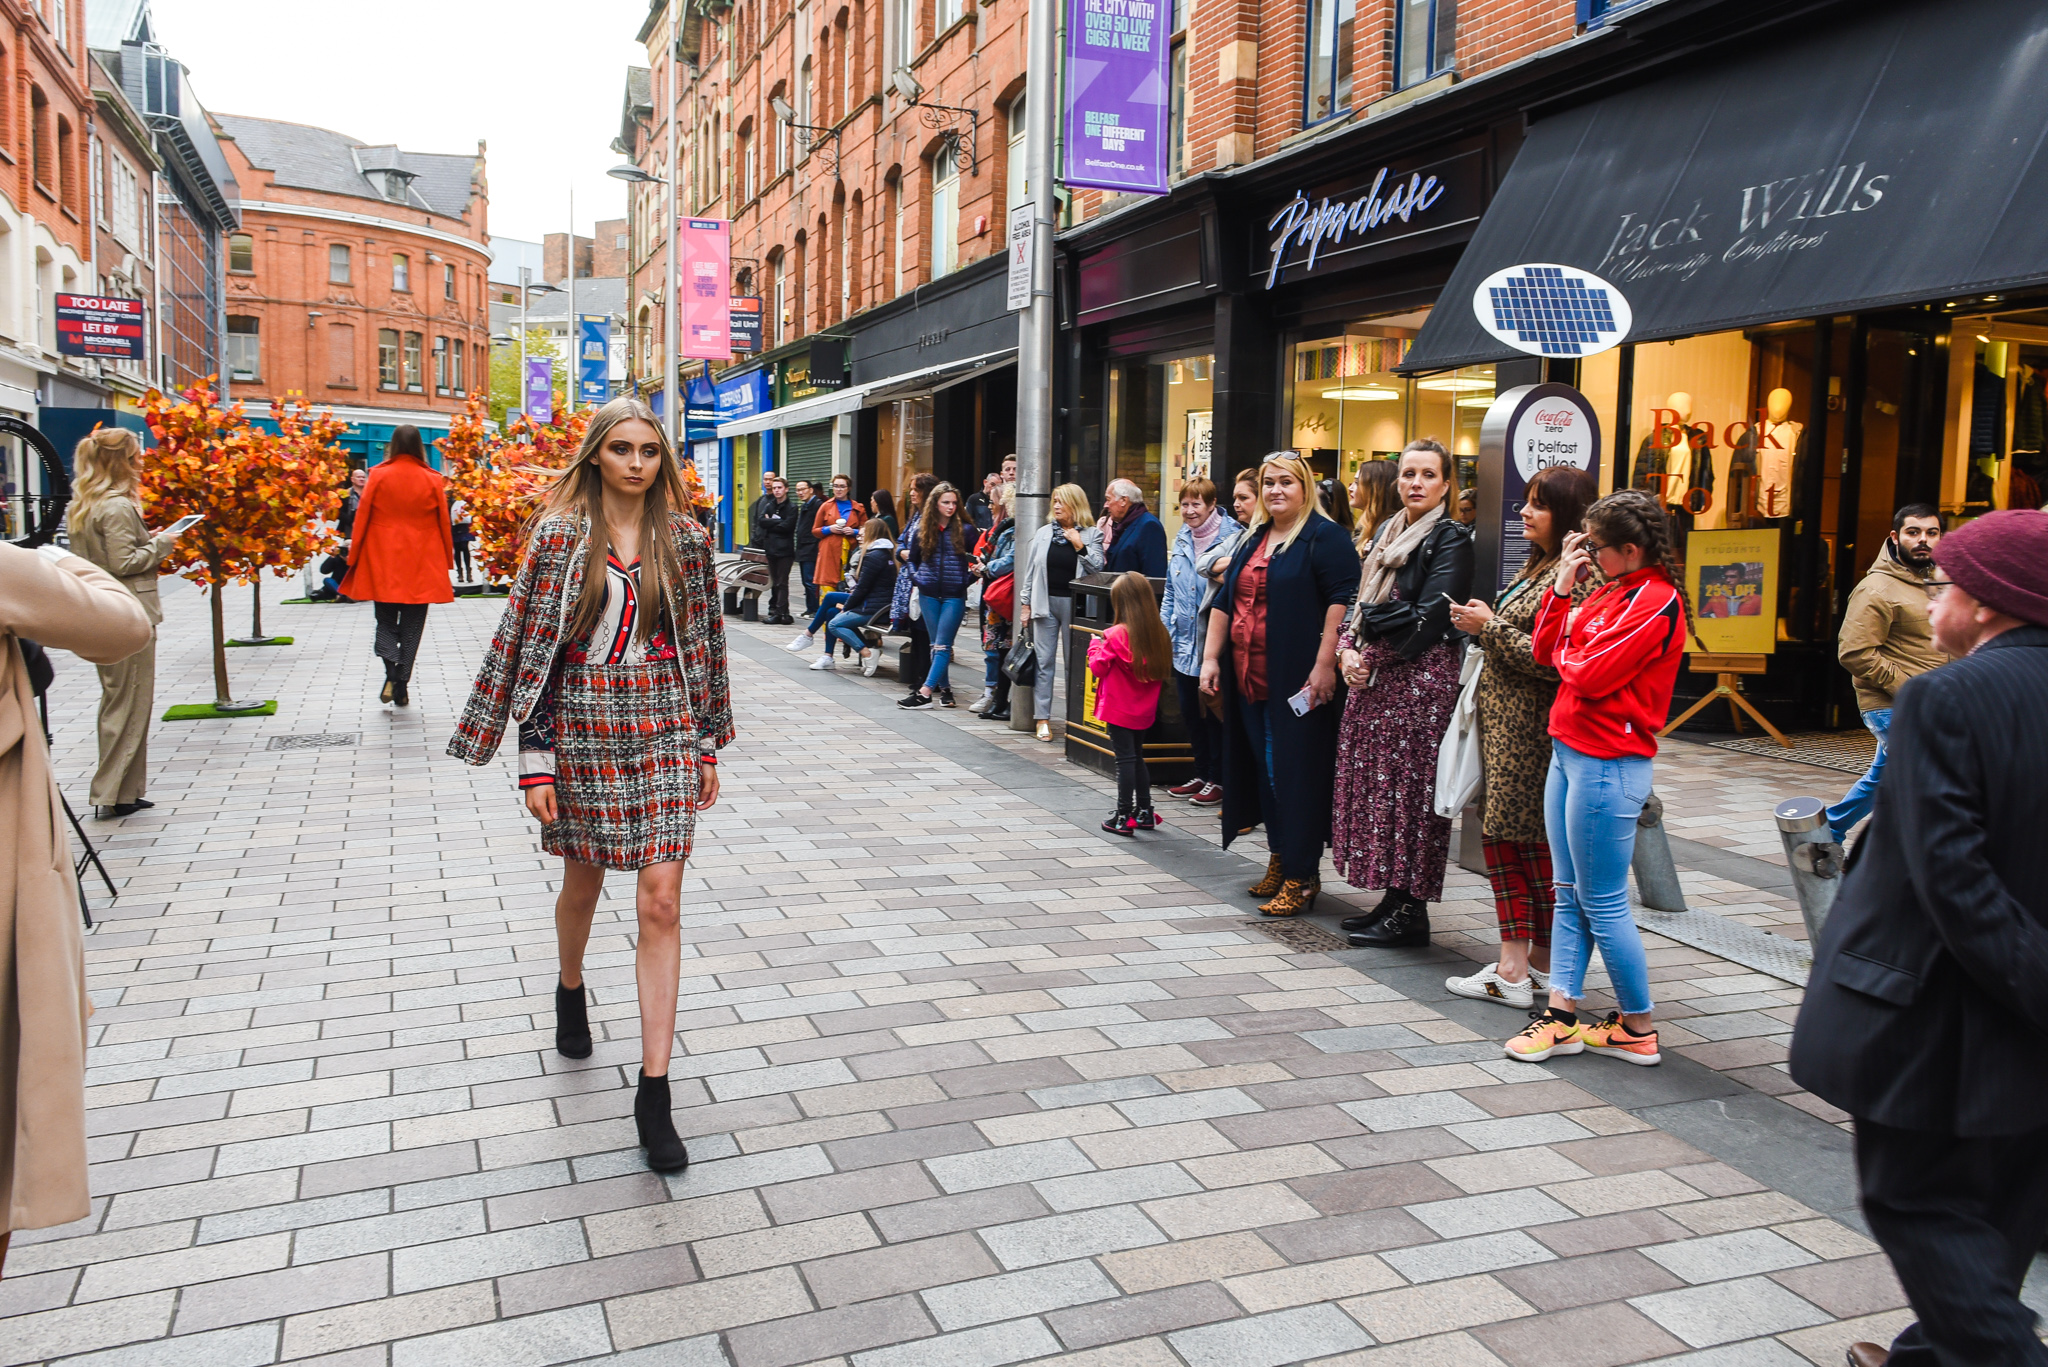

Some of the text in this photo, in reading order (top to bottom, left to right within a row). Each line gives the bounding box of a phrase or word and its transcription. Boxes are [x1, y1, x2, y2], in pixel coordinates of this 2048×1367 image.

[1103, 0, 1128, 16] CITY
[1128, 1, 1155, 19] WITH
[1085, 12, 1152, 36] OVER 50 LIVE
[1085, 29, 1151, 52] GIGS A WEEK
[1085, 110, 1120, 126] BELFAST
[1085, 123, 1146, 141] ONE DIFFERENT
[1102, 137, 1125, 152] DAYS
[1084, 158, 1145, 171] BelfastOne.co.uk
[1595, 161, 1891, 272] Jack Wills
[1265, 167, 1445, 290] Paperchase
[1609, 230, 1829, 284] University Outfitters
[71, 297, 130, 311] TOO LATE
[729, 298, 744, 307] LET
[83, 323, 119, 334] LET BY
[729, 320, 759, 328] tail Unit
[1544, 425, 1563, 433] zero
[1648, 407, 1785, 450] Back
[1538, 439, 1578, 454] belfast
[1537, 454, 1577, 471] bikes
[1645, 473, 1782, 517] To It
[1704, 546, 1761, 554] STUDENTS
[1705, 583, 1757, 597] 25% OFF
[1782, 808, 1798, 817] 2
